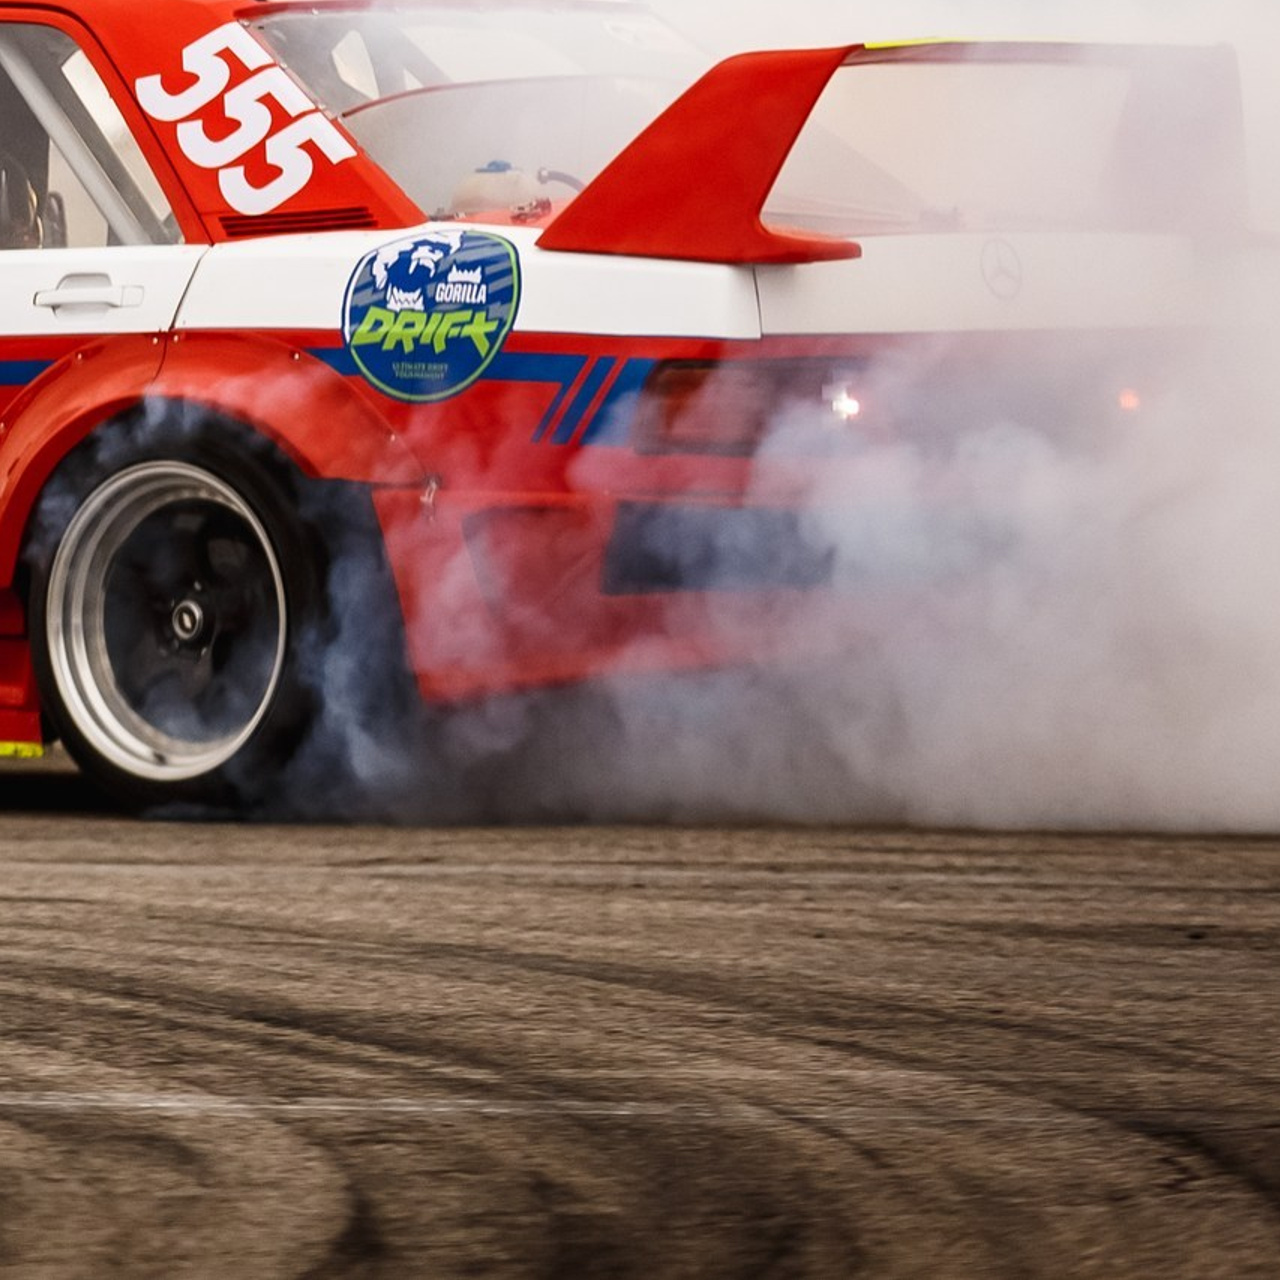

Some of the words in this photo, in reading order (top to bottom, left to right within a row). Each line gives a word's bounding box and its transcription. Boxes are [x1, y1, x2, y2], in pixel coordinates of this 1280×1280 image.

[135, 21, 357, 216] 555
[435, 282, 487, 305] GORILLA
[351, 306, 499, 359] DRIFT
